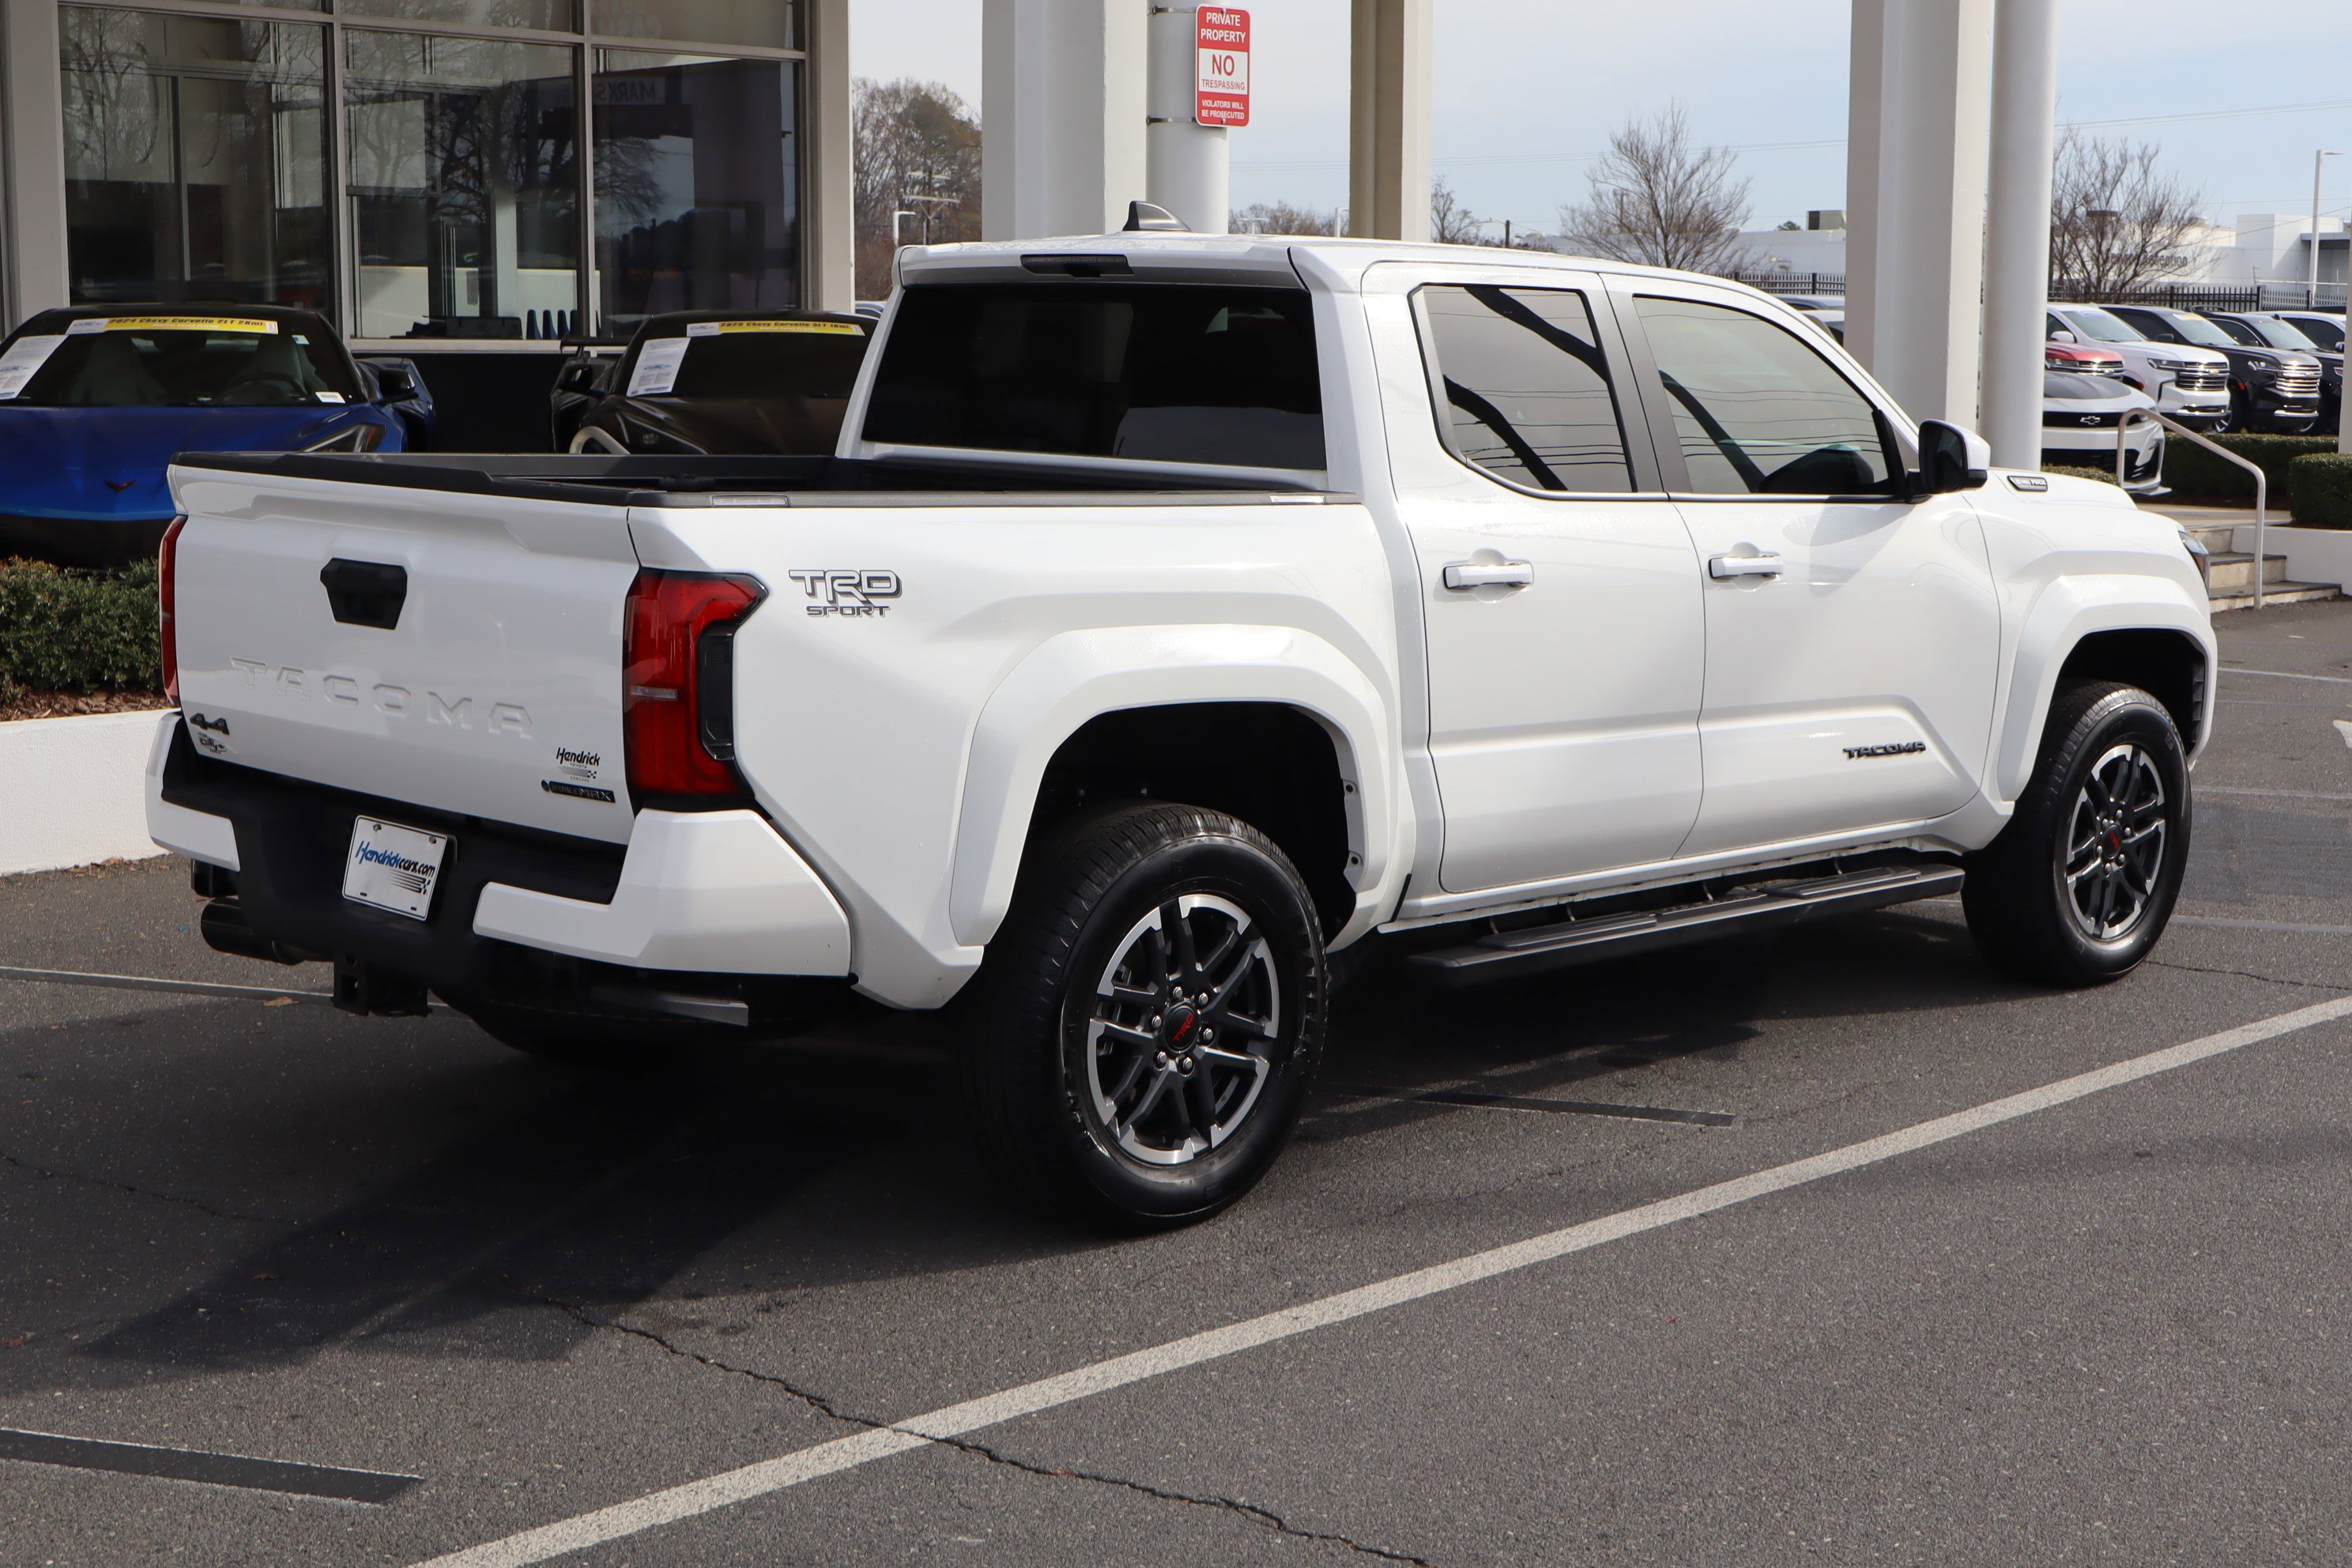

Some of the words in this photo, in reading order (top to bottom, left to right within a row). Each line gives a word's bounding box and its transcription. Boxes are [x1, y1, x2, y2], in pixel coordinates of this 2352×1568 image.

[1206, 12, 1241, 27] PRIVATE
[1200, 28, 1246, 43] PROPERTY
[1212, 54, 1235, 76] NO
[1201, 79, 1246, 91] TRESPASSING
[1201, 100, 1231, 109] VIOLATORS
[1231, 101, 1245, 110] WILL
[1201, 109, 1209, 118] BE
[1209, 110, 1245, 120] PROSECUTED
[789, 569, 903, 605] TRD
[806, 605, 891, 617] SPORT
[230, 656, 533, 740] TACOMA
[556, 747, 601, 767] Hendrick
[1842, 741, 1927, 759] TACOMA
[355, 840, 436, 878] Hendrickcars.com
